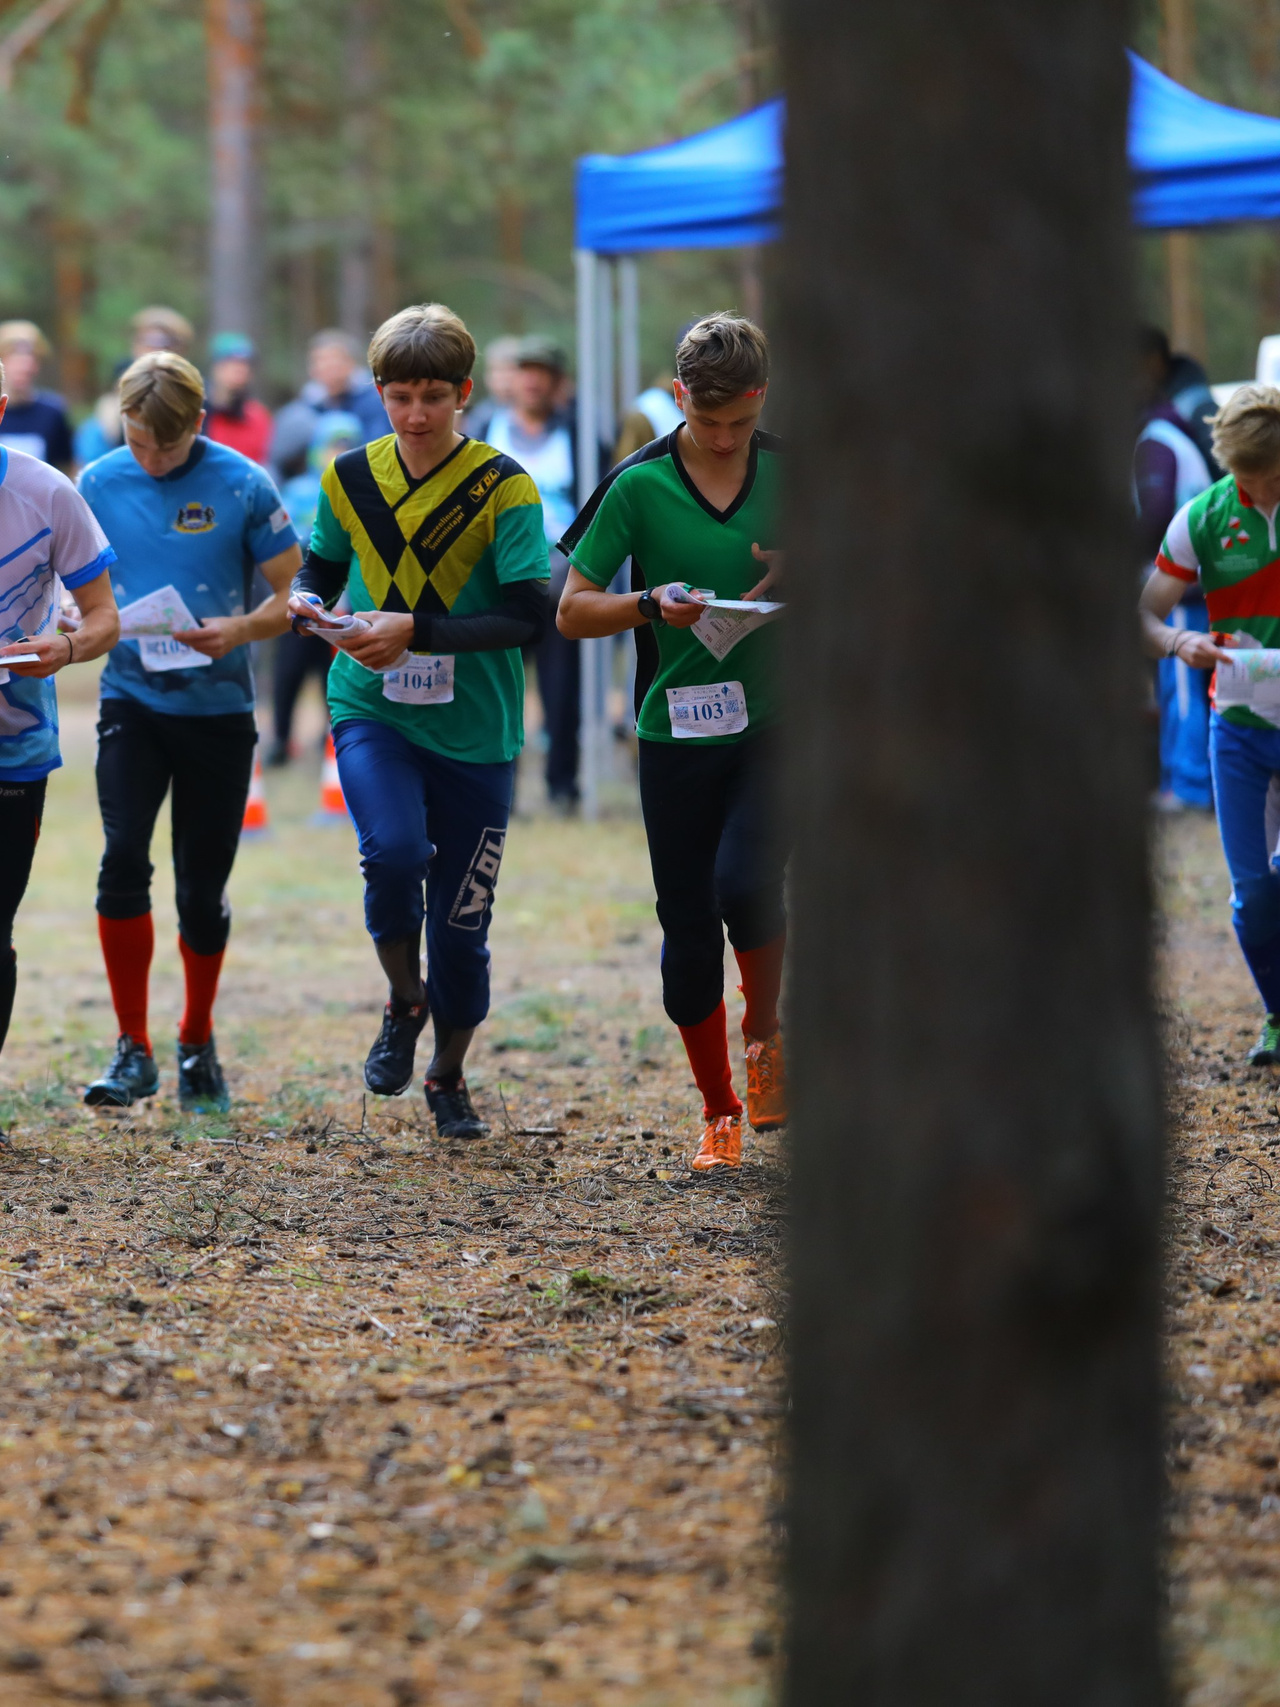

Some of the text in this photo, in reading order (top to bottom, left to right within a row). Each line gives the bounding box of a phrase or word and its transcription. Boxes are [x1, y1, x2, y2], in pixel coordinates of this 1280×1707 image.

[428, 512, 465, 551] Suunnistajat
[403, 672, 433, 690] 104
[692, 702, 724, 721] 103
